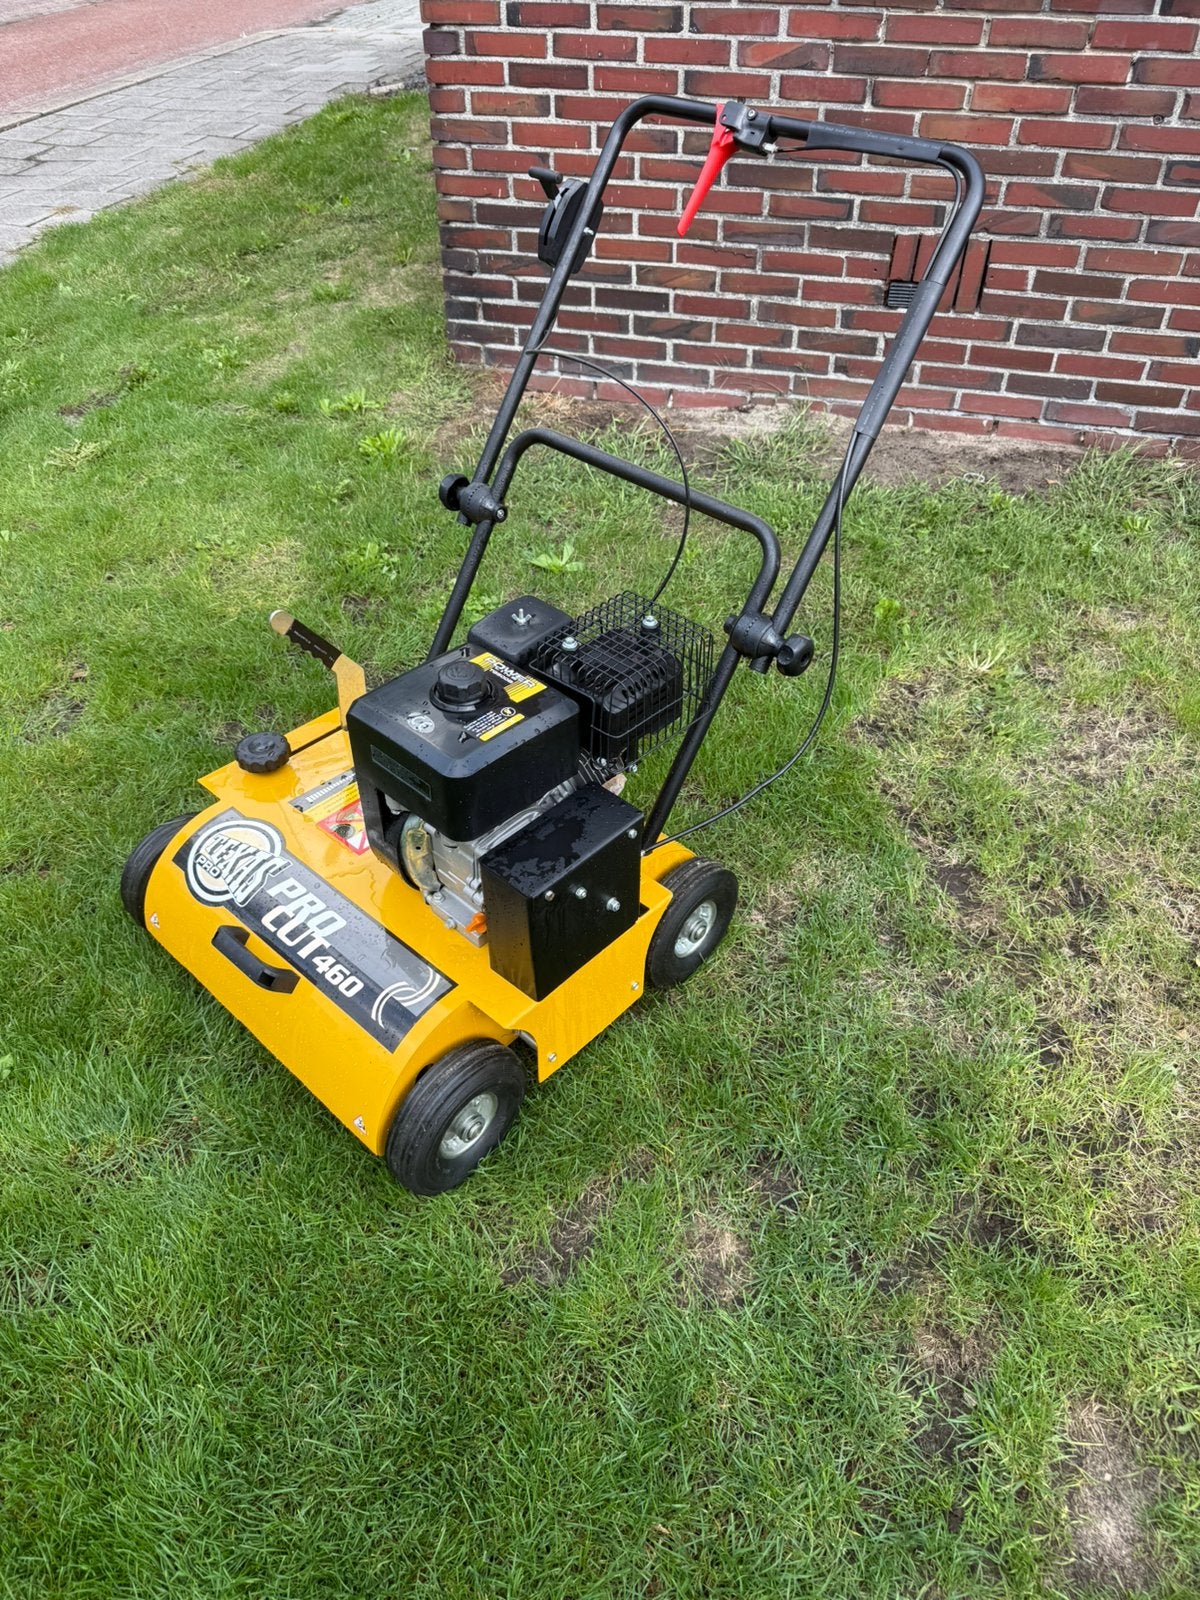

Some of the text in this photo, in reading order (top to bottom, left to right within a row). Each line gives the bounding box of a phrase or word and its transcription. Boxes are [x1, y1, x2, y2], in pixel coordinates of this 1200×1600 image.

[484, 657, 535, 688] POWER
[195, 853, 222, 879] PRO
[205, 834, 292, 906] TEXAS
[266, 877, 347, 937] PRO
[261, 905, 365, 998] CUT 460
